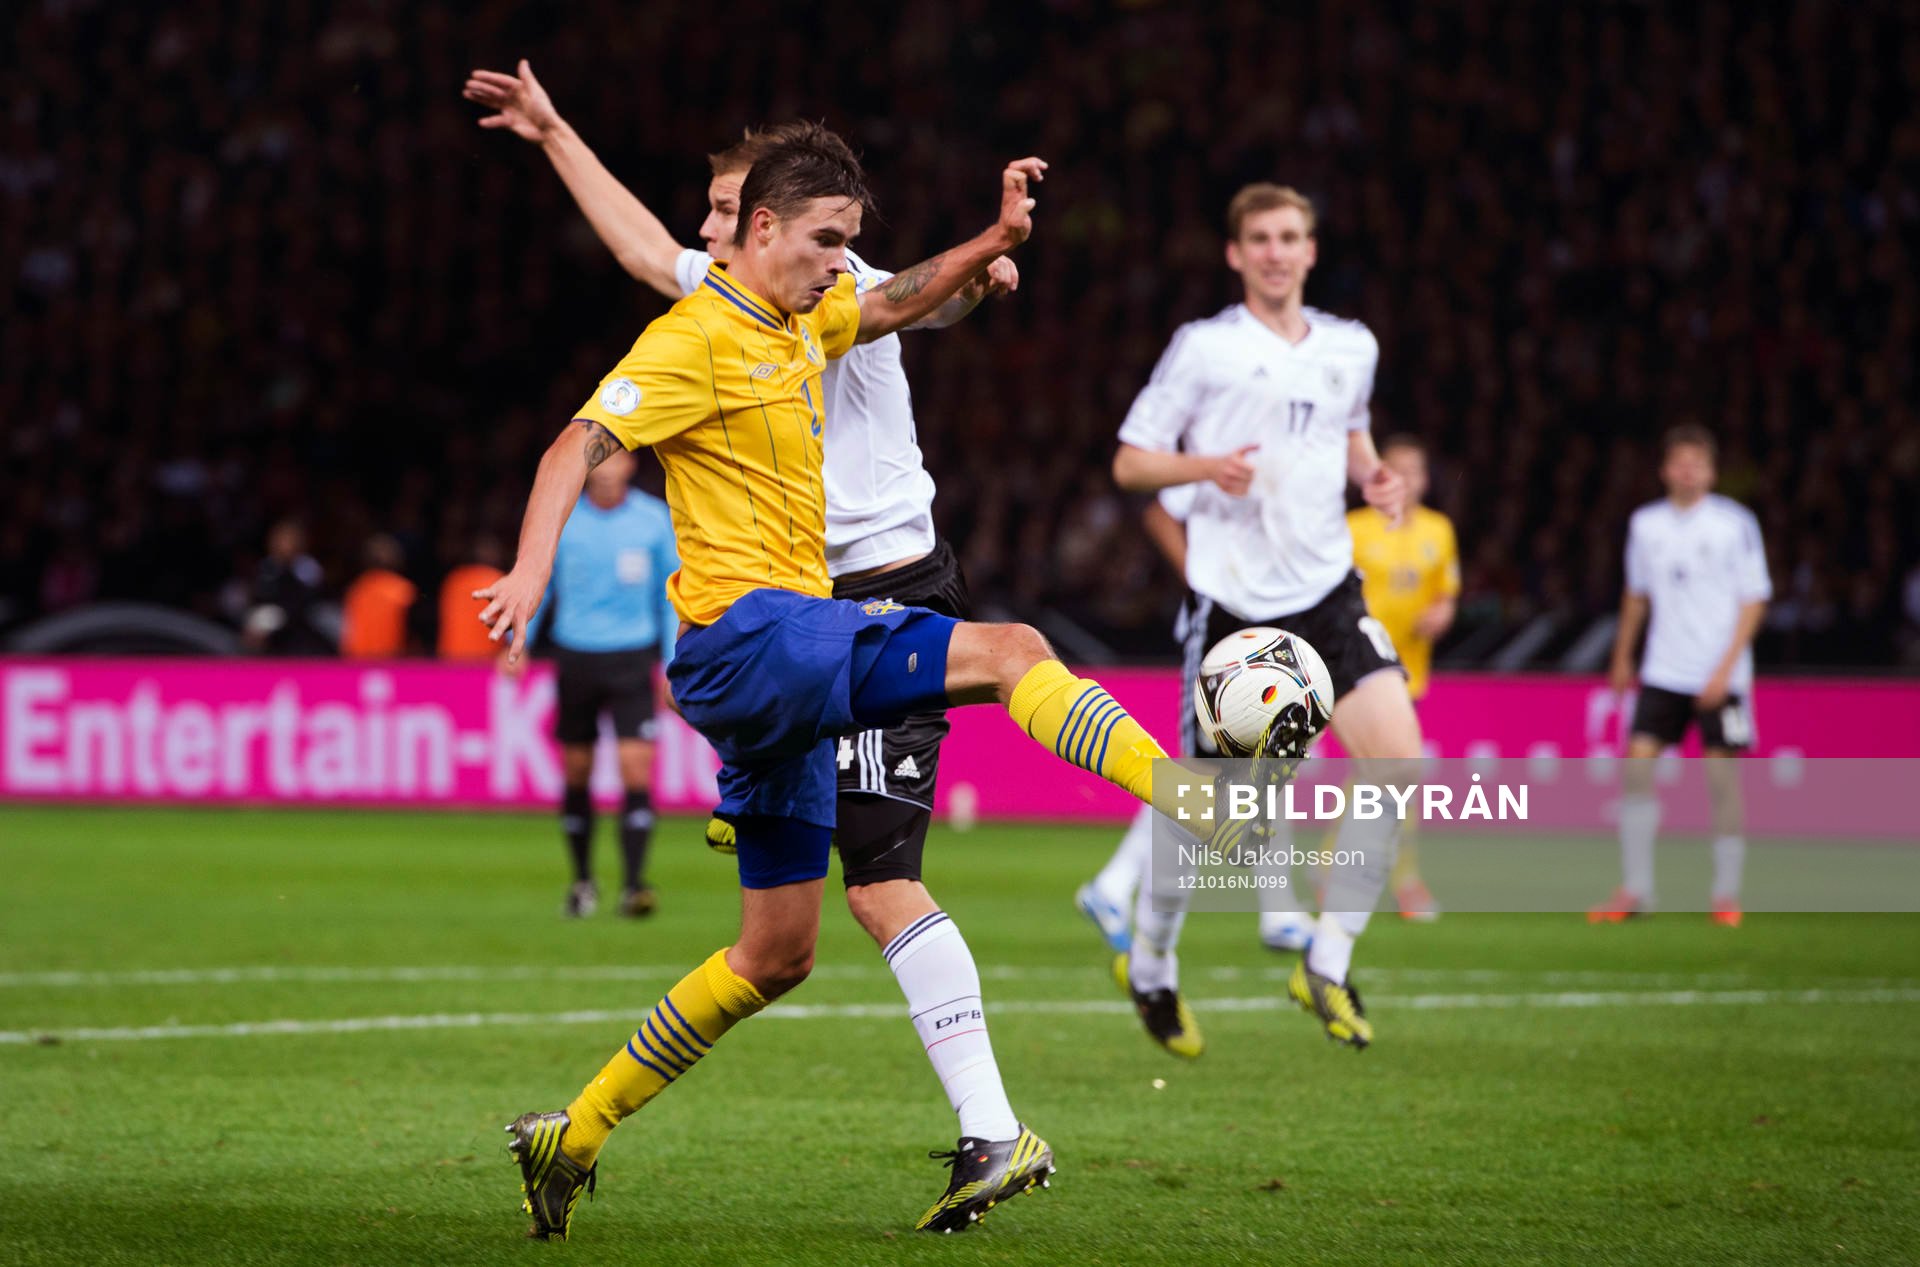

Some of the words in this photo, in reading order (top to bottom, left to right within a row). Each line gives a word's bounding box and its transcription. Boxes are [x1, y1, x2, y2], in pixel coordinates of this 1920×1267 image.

[1289, 401, 1315, 434] 17
[835, 736, 854, 770] 4
[935, 1010, 981, 1030] DFB
